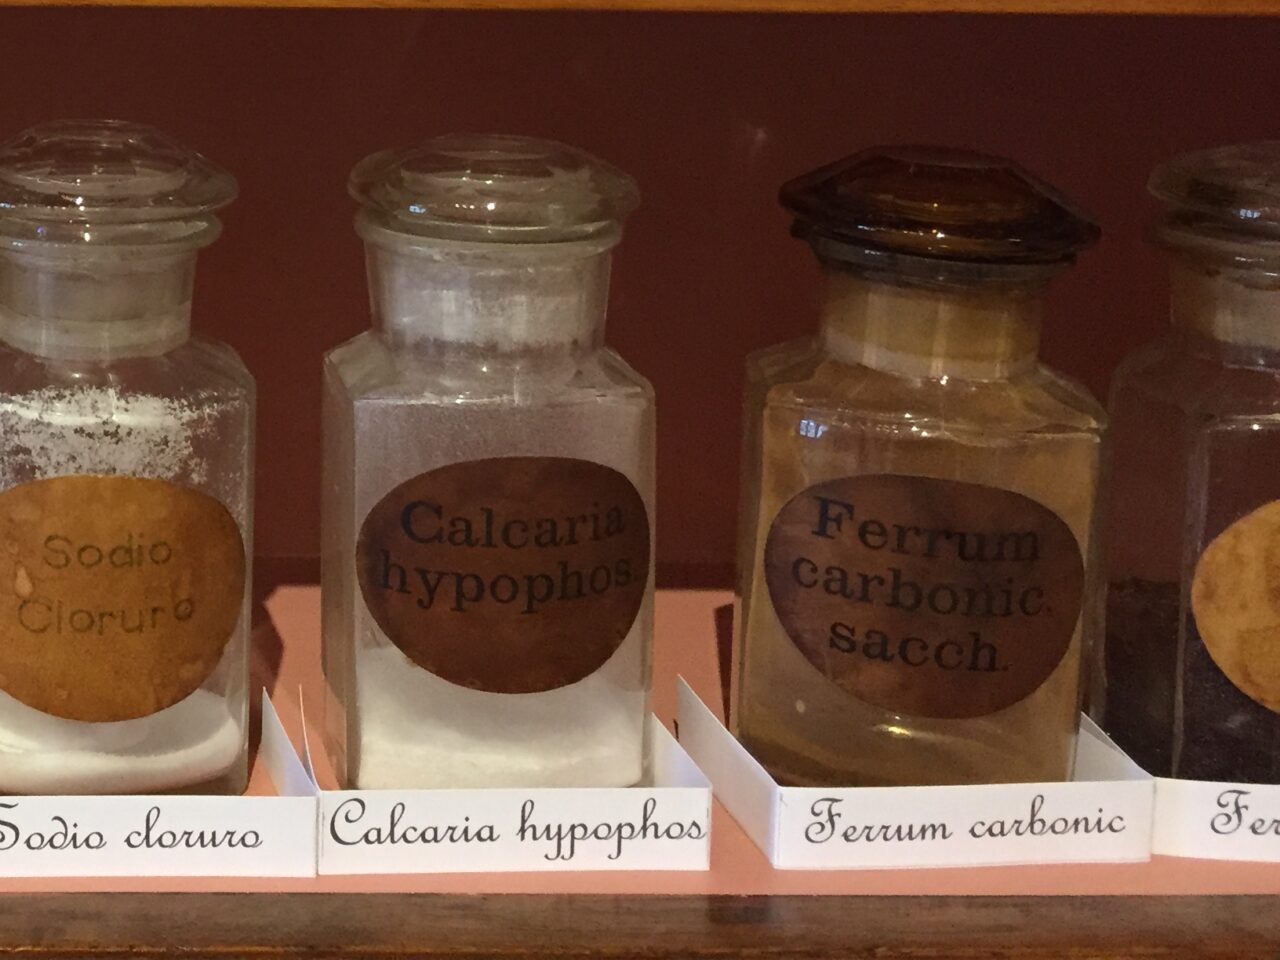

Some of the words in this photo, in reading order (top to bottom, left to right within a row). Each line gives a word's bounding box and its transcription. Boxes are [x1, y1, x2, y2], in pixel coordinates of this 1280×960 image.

[400, 500, 627, 550] Calcaria
[811, 495, 1042, 563] Ferrum
[43, 533, 172, 570] Sodio
[18, 597, 195, 636] Cloruro
[829, 621, 1011, 673] sacch.
[123, 805, 264, 849] cloruro
[329, 797, 501, 846] Calcaria
[515, 797, 706, 862] hypophos
[804, 797, 954, 844] Ferrum
[968, 794, 1126, 839] carbonic
